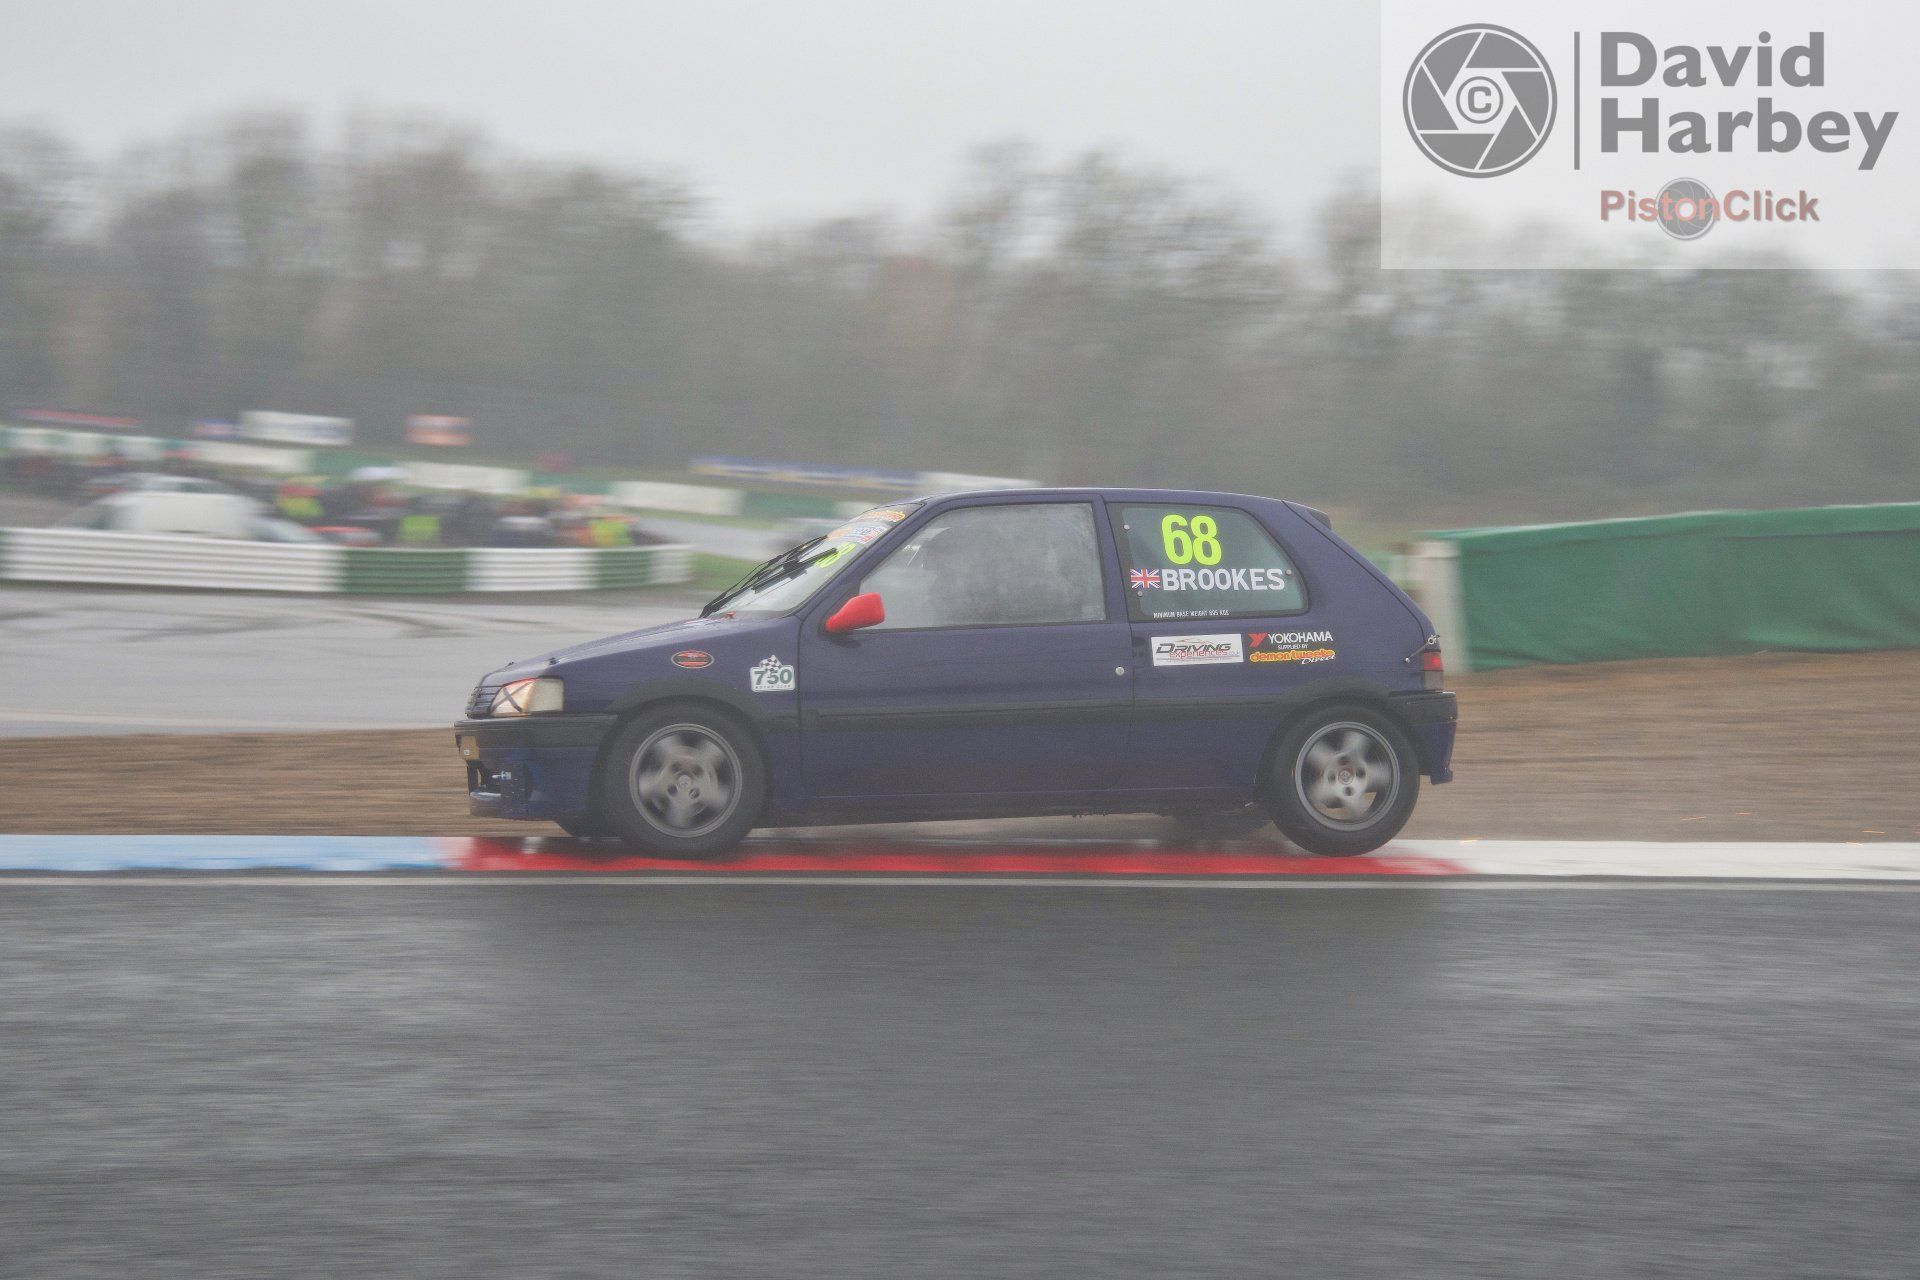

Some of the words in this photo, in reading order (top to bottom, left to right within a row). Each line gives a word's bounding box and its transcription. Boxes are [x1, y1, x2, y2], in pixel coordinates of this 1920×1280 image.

[1161, 514, 1222, 566] 68
[1161, 568, 1285, 591] BROOKES
[1268, 631, 1334, 643] YOKOHAMA
[1169, 649, 1228, 659] experiences
[1250, 651, 1291, 662] demon
[754, 669, 793, 685] 750
